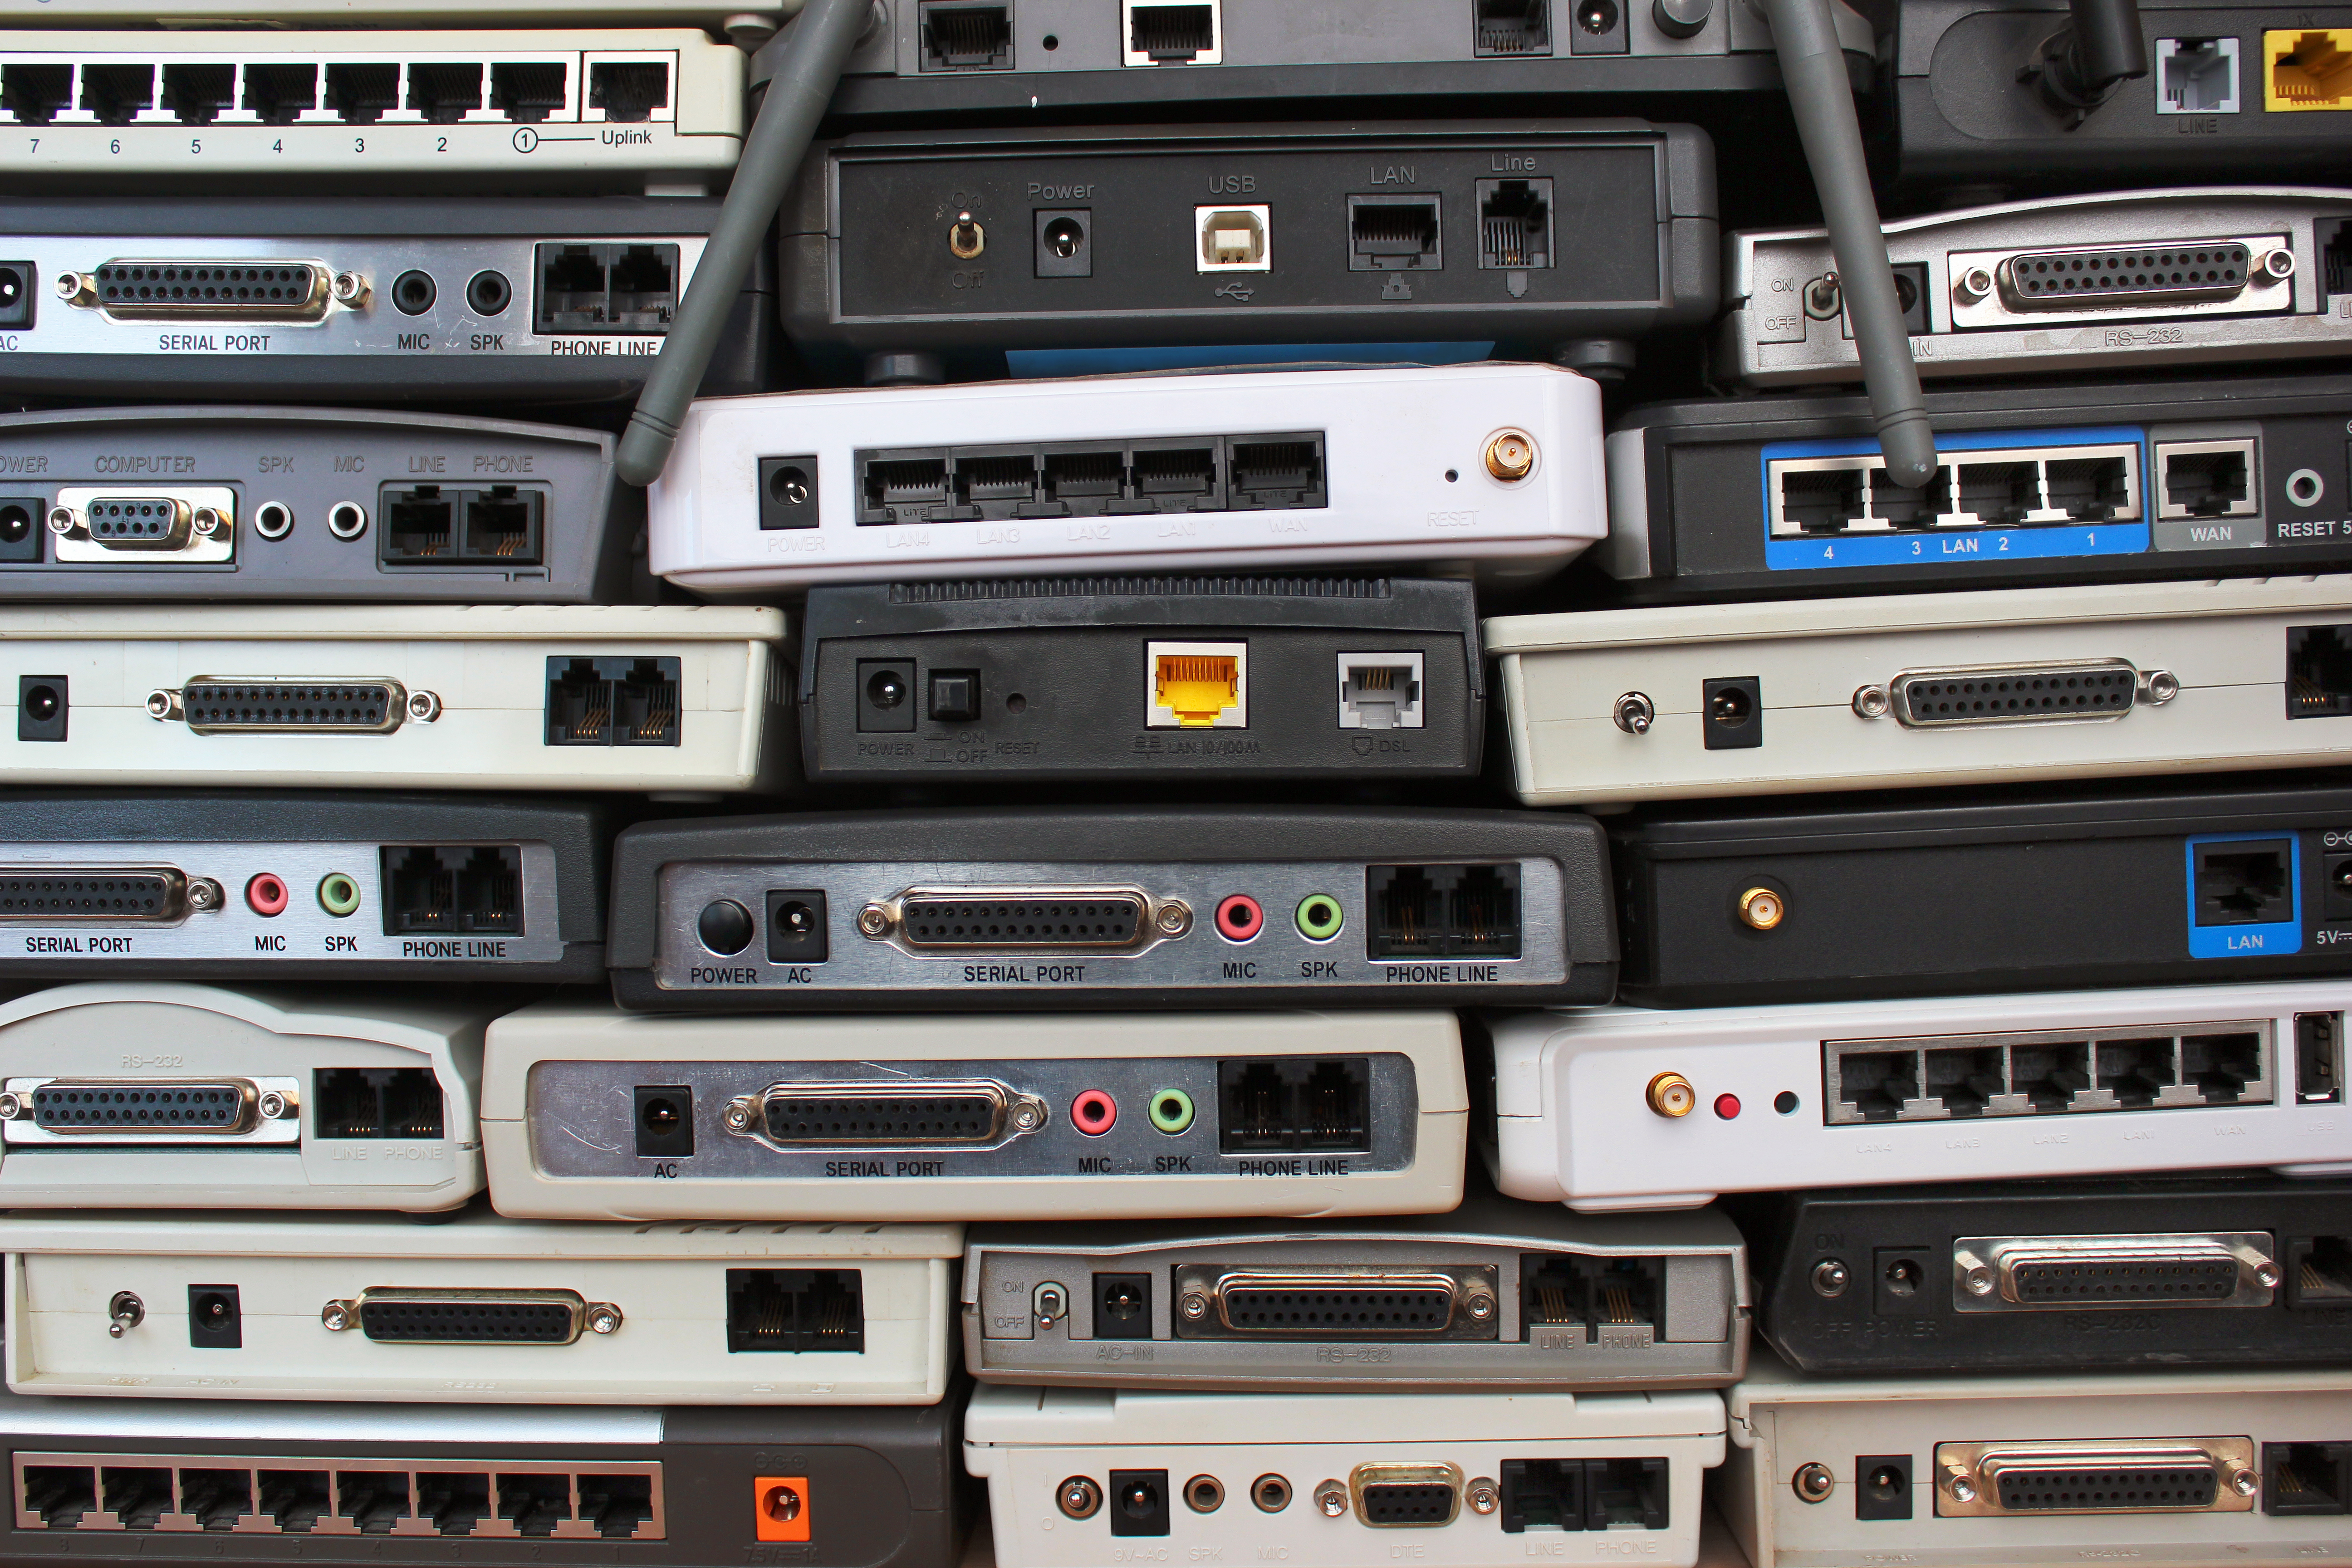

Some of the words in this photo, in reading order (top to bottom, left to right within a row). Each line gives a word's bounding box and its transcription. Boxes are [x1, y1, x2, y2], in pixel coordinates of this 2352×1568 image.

[2178, 119, 2217, 134] LINE
[30, 139, 40, 153] 7
[111, 140, 121, 154] 6
[191, 140, 201, 153] 5
[273, 139, 283, 153] 4
[355, 138, 365, 152] 3
[437, 137, 447, 152] 2
[602, 130, 652, 148] Uplink
[1490, 154, 1536, 173] Line
[1370, 166, 1415, 185] LAN
[1027, 182, 1094, 201] Power
[1208, 175, 1256, 194] USB
[951, 191, 981, 208] On
[951, 272, 985, 289] Off
[1771, 279, 1793, 293] ON
[1765, 316, 1796, 330] OFF
[160, 335, 218, 350] SERIAL
[225, 335, 271, 351] PORT
[398, 334, 430, 349] MIC
[470, 335, 504, 350] SPK
[2105, 328, 2182, 346] RS-232
[552, 341, 611, 356] PHONE
[618, 341, 657, 356] LINE
[94, 456, 196, 473] COMPUTER
[258, 456, 294, 472] SPK
[334, 456, 364, 472] MIC
[409, 456, 445, 472] LINE
[473, 456, 533, 472] PHONE
[1270, 517, 1308, 533] WAN
[1428, 509, 1479, 527] RESET
[1067, 524, 1110, 541] LAN2
[1157, 520, 1196, 536] LAN1
[2190, 526, 2231, 542] WAN
[2278, 521, 2336, 538] RESET
[2342, 520, 2352, 534] 5
[768, 535, 825, 552] POWER
[886, 531, 930, 548] LAN4
[977, 528, 1020, 544] LAN3
[1824, 546, 1833, 560] 4
[1911, 541, 1921, 555] 3
[1942, 539, 1979, 554] LAN
[1999, 538, 2009, 551] 2
[2087, 533, 2094, 546] 1
[958, 730, 985, 744] ON
[858, 742, 914, 755] POWER
[995, 741, 1039, 754] RESET
[1168, 740, 1197, 754] LAN
[1379, 740, 1411, 753] DSL
[956, 749, 988, 762] OFF
[26, 937, 83, 952] SERIAL
[89, 937, 132, 952] PORT
[255, 936, 286, 951] MIC
[325, 936, 358, 951] SPK
[403, 941, 462, 957] PHONE
[468, 941, 506, 957] LINE
[2228, 935, 2263, 950] LAN
[691, 968, 757, 984] POWER
[787, 968, 812, 984] AC
[964, 966, 1030, 982] SERIAL
[1037, 966, 1085, 982] PORT
[1223, 962, 1257, 978] MIC
[1301, 961, 1338, 977] SPK
[1387, 966, 1450, 982] PHONE
[1457, 965, 1498, 982] LINE
[122, 1054, 183, 1069] RS-232
[2214, 1125, 2246, 1136] WAN
[2307, 1121, 2334, 1132] USB
[2033, 1134, 2069, 1146] LAN2
[2123, 1129, 2155, 1141] LAN1
[1856, 1142, 1892, 1154] LAN4
[1945, 1138, 1981, 1150] LAN3
[331, 1147, 368, 1160] LINE
[384, 1147, 443, 1160] PHONE
[654, 1163, 678, 1179] AC
[826, 1161, 890, 1177] SERIAL
[897, 1161, 944, 1176] PORT
[1078, 1157, 1112, 1173] MIC
[1155, 1156, 1192, 1173] SPK
[1239, 1161, 1301, 1177] PHONE
[1308, 1160, 1348, 1176] LINE
[1815, 1234, 1844, 1252] ON
[1002, 1280, 1024, 1293] ON
[994, 1316, 1024, 1329] OFF
[1814, 1321, 1851, 1338] OFF
[1865, 1321, 1939, 1337] POWER
[1541, 1335, 1574, 1350] LINE
[1602, 1334, 1651, 1349] PHONE
[1096, 1345, 1154, 1361] AC-IN
[1317, 1347, 1392, 1363] RS-232
[60, 1536, 69, 1552] 8
[136, 1538, 144, 1553] 7
[215, 1539, 224, 1555] 6
[293, 1540, 302, 1555] 5
[372, 1540, 382, 1556] 4
[451, 1543, 461, 1558] 3
[531, 1545, 541, 1560] 2
[615, 1546, 620, 1561] 1
[1189, 1547, 1223, 1561] SPK
[1257, 1546, 1289, 1560] MIC
[1390, 1544, 1425, 1558] DTE
[1525, 1541, 1564, 1556] LINE
[1595, 1540, 1657, 1555] PHONE
